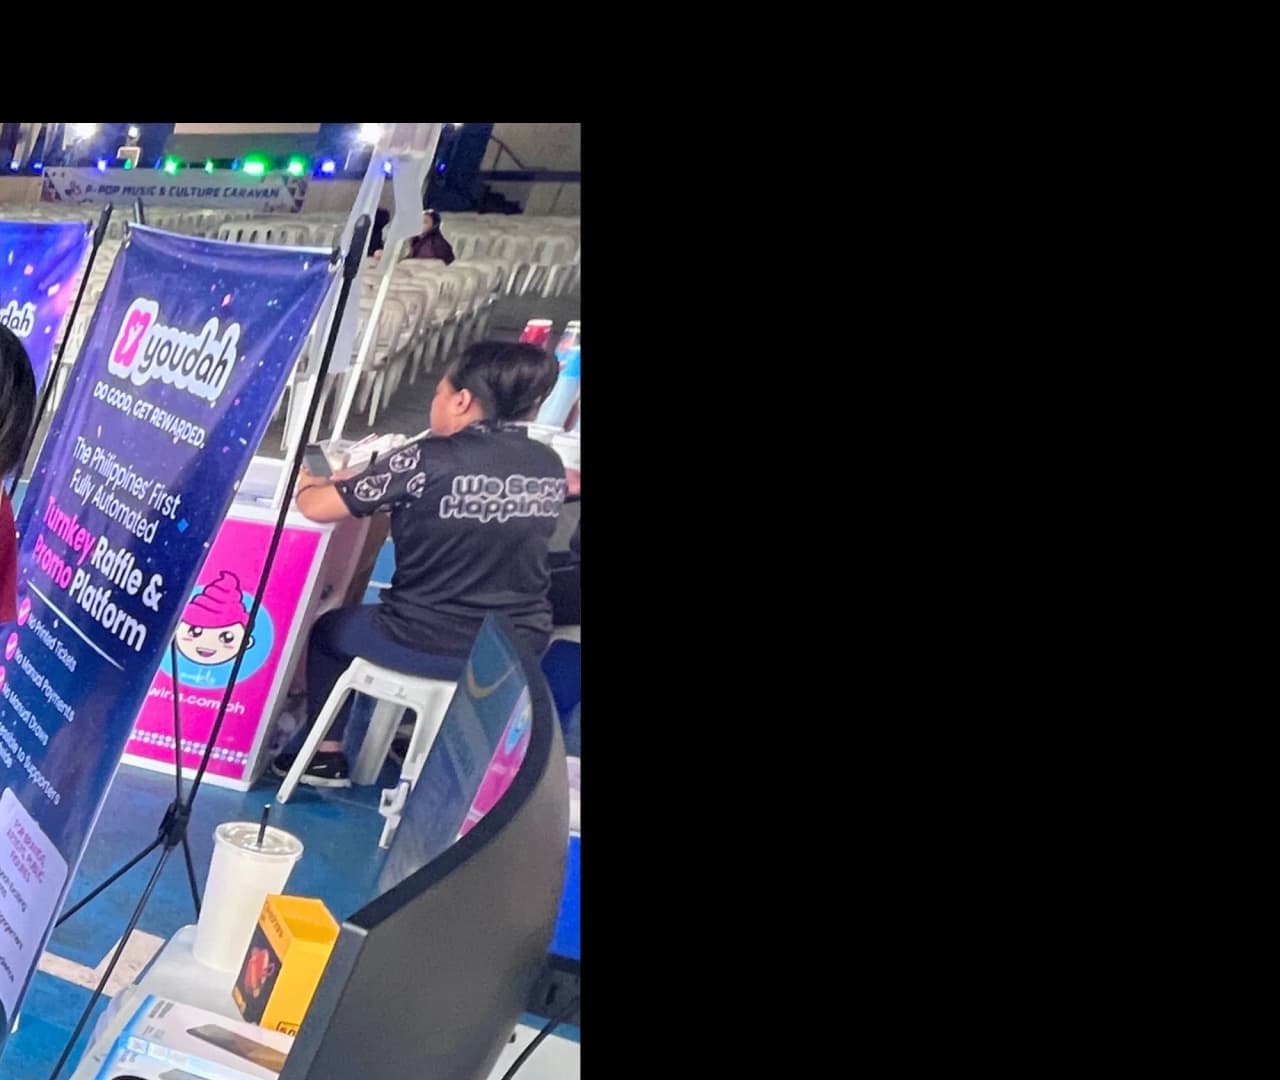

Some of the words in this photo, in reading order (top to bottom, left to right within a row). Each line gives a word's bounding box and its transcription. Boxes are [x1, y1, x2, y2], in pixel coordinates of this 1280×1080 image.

[85, 184, 121, 196] P-POP
[122, 185, 157, 197] MUSIC
[168, 186, 219, 198] CULTURE
[222, 187, 281, 199] CARAVAN
[137, 328, 230, 389] youdah
[93, 381, 108, 401] DO
[132, 400, 152, 421] GET
[69, 468, 91, 506] Fully
[91, 484, 160, 545] Automated
[72, 436, 92, 466] The
[148, 481, 182, 520] First
[452, 474, 504, 498] We
[42, 495, 97, 567] Turnkey
[91, 535, 144, 596] Raffle
[142, 573, 164, 613] &
[31, 533, 74, 590] Promo
[68, 567, 148, 653] Platform
